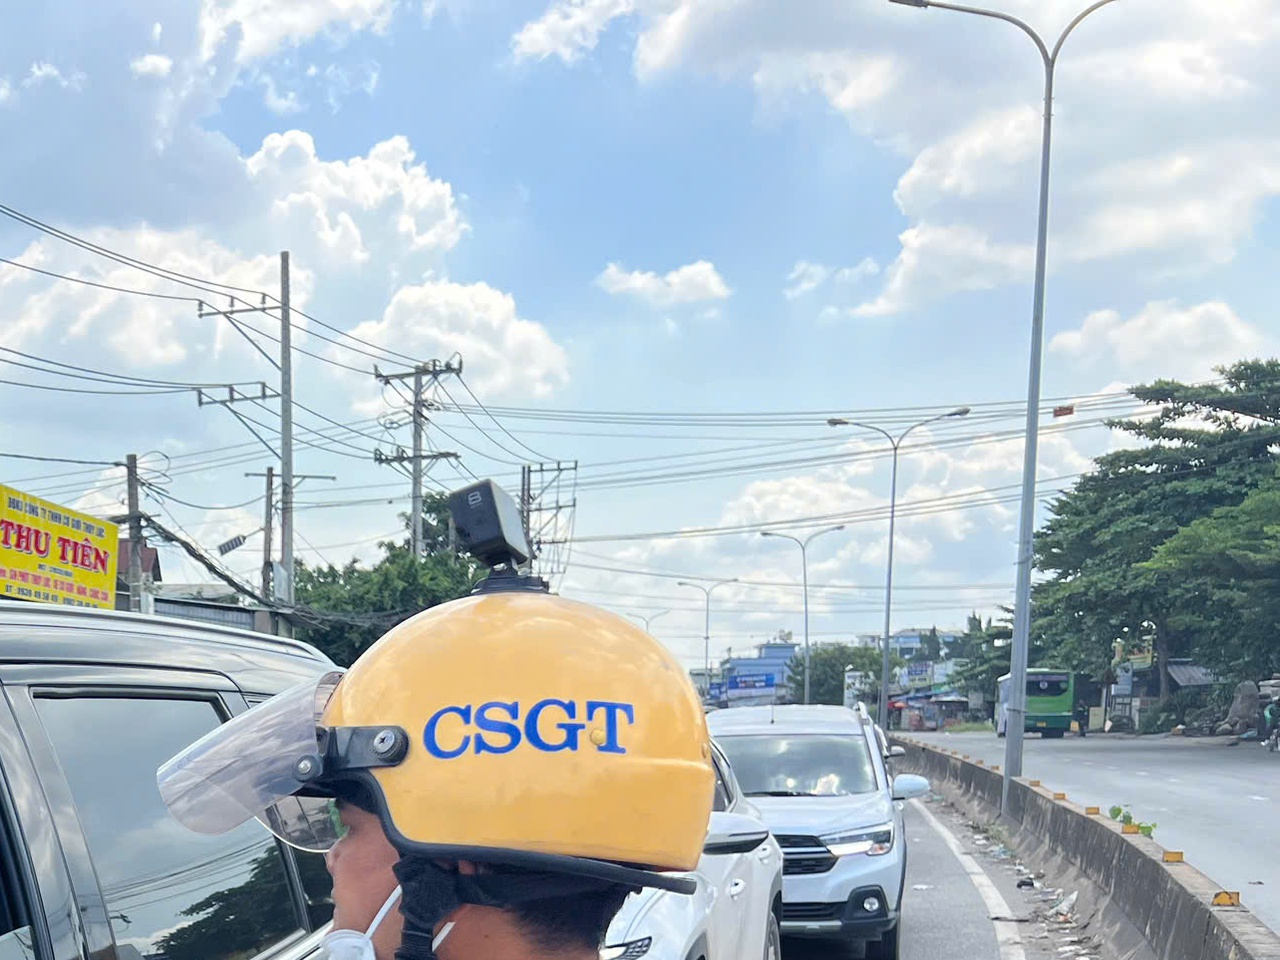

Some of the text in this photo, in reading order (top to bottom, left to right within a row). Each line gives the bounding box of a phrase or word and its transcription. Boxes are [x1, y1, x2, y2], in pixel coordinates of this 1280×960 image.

[0, 518, 51, 559] THU
[57, 537, 109, 575] TIÊN
[423, 698, 634, 759] CSGT
